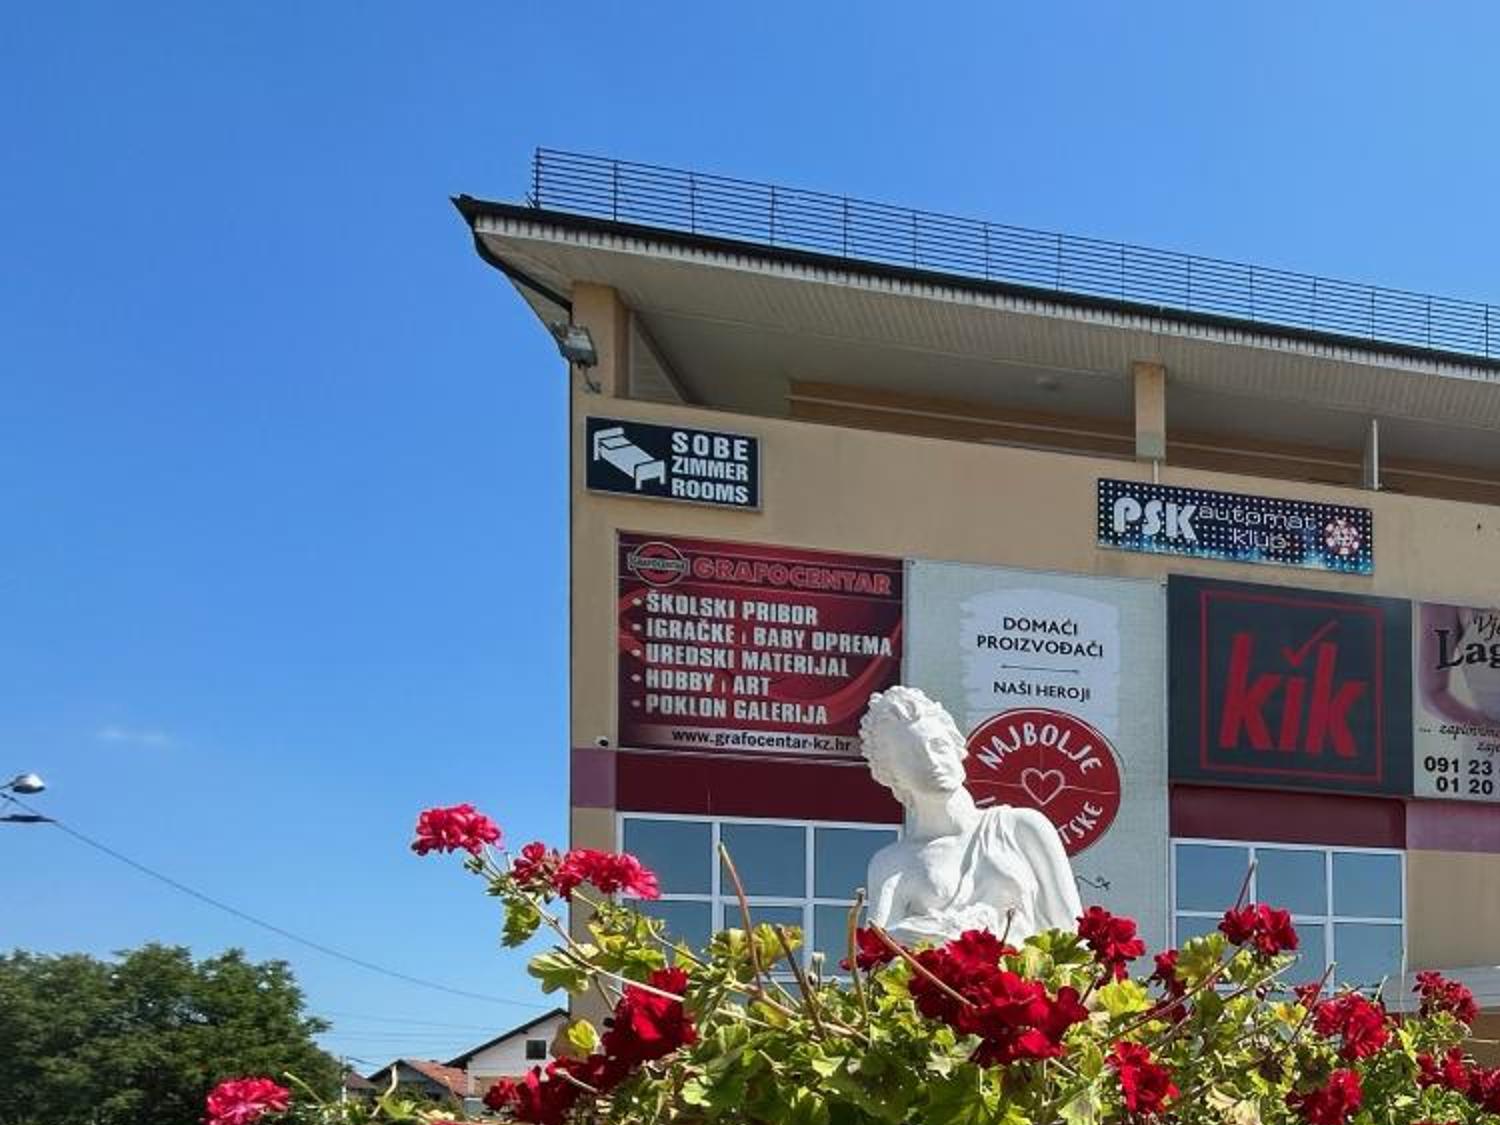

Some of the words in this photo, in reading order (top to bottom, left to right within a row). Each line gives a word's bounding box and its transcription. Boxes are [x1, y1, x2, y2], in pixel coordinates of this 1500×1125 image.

[672, 432, 748, 460] SOBE
[672, 455, 749, 482] ZIMMER
[672, 478, 749, 504] ROOMS
[1113, 496, 1197, 541] PSK
[1199, 505, 1317, 531] automat
[692, 557, 892, 594] GRAFOCENTAR
[646, 589, 735, 619] ŠKOLSKI
[742, 600, 818, 626] PRIBOR
[646, 616, 735, 644] IGRAČKE
[753, 627, 806, 649] BABY
[811, 631, 893, 656] OPREMA
[1003, 617, 1078, 637] DOMAĆI
[977, 634, 1104, 658] PROIZVOĐAČI
[645, 643, 735, 669] UREDSKI
[741, 650, 850, 678] MATERIJAL
[645, 668, 715, 693] HOBBY
[733, 675, 770, 697] ART
[993, 680, 1032, 697] NAŠI
[1035, 685, 1091, 703] HEROJI
[645, 694, 727, 719] POKLON
[733, 702, 828, 725] GALERIJA
[671, 729, 851, 752] www.grafocentar-kz.hr
[975, 721, 1103, 775] NAJBOLJE
[1424, 756, 1461, 774] 091
[1468, 760, 1493, 776] 23
[1436, 776, 1460, 793] 01
[1468, 779, 1494, 796] 20
[1058, 801, 1104, 845] TSKE
